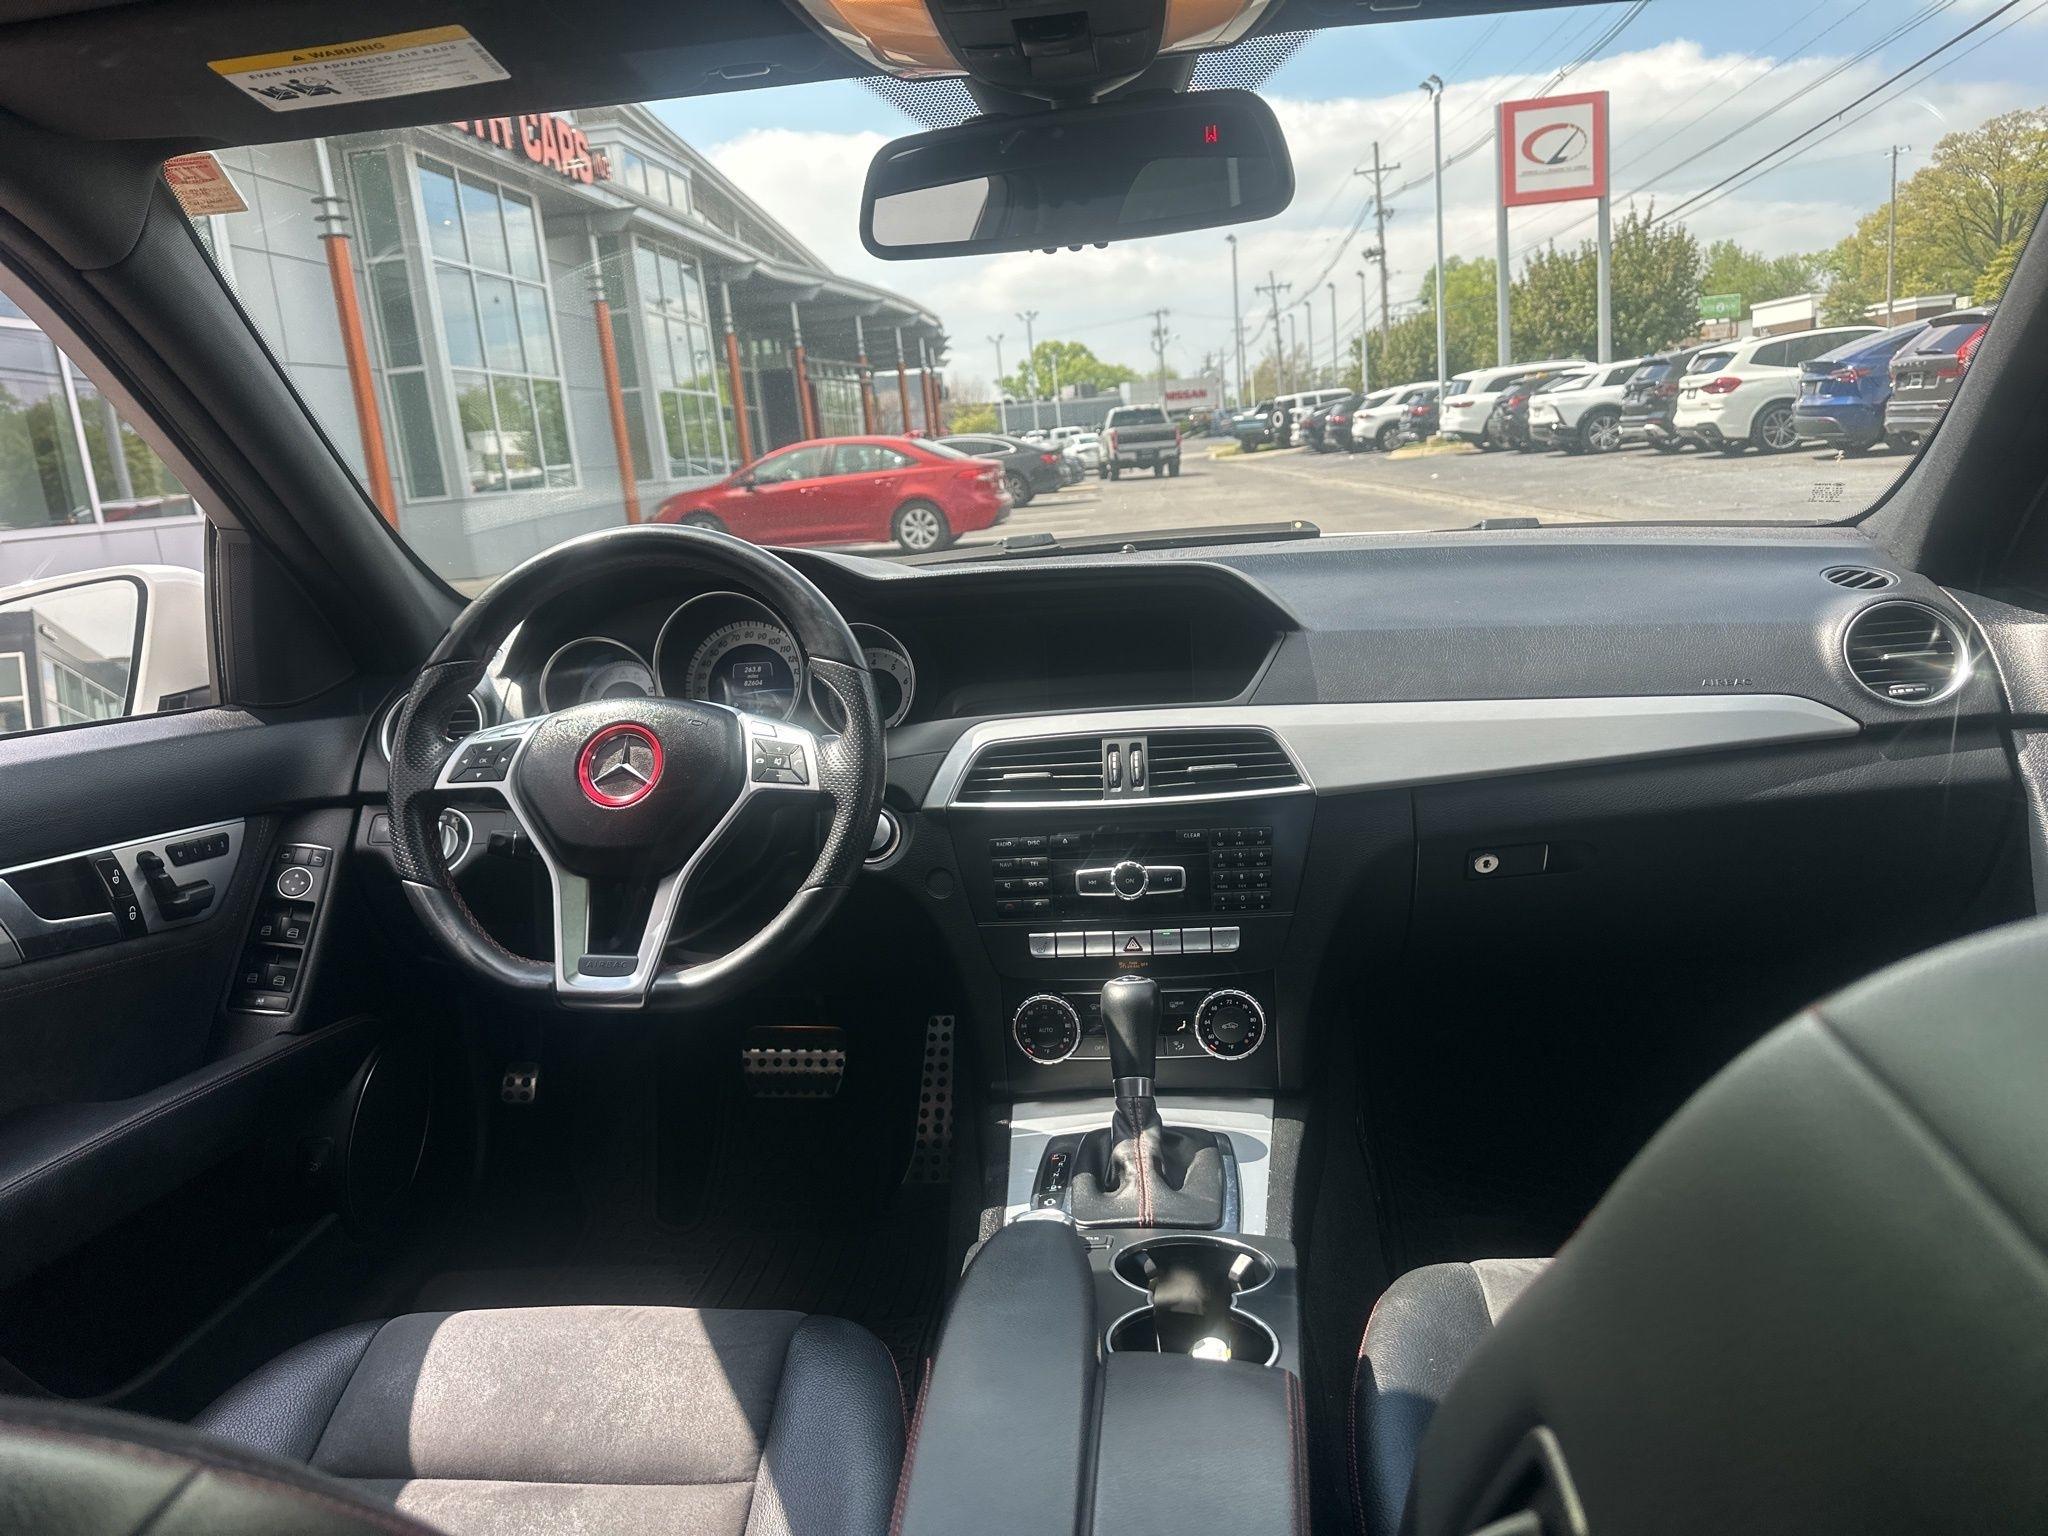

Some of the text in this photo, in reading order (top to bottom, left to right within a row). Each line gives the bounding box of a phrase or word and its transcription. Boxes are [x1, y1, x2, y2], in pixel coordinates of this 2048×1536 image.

[308, 42, 385, 59] WARNING
[249, 44, 457, 80] EVEN WITH ADVANCED AIR BAGS
[1165, 389, 1207, 400] NISSAN
[744, 631, 754, 639] 80
[757, 632, 767, 640] 90
[768, 637, 781, 645] 100
[780, 644, 791, 653] 110
